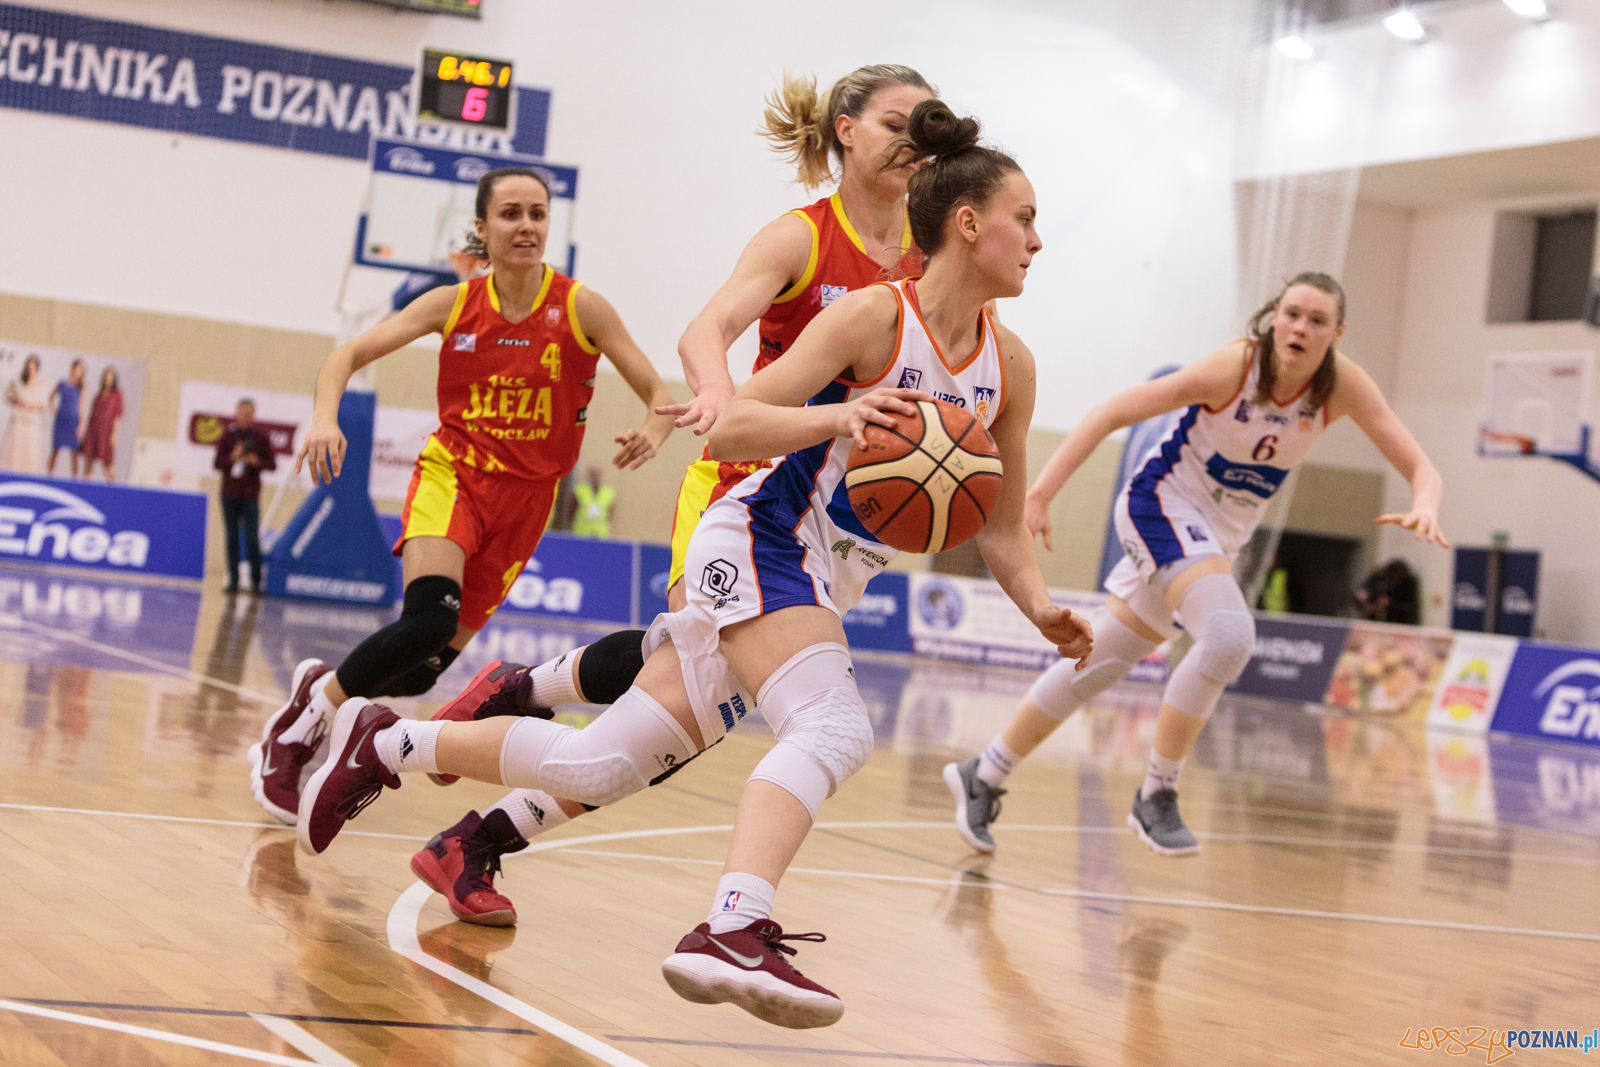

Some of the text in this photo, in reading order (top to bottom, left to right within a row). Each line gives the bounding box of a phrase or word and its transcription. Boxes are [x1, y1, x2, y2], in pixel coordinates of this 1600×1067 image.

[461, 87, 489, 122] 6
[496, 338, 530, 347] zina
[540, 342, 561, 381] 4
[1252, 434, 1278, 461] 6
[0, 504, 151, 568] Enea
[855, 547, 889, 567] AVENIDA
[504, 573, 583, 613] ea
